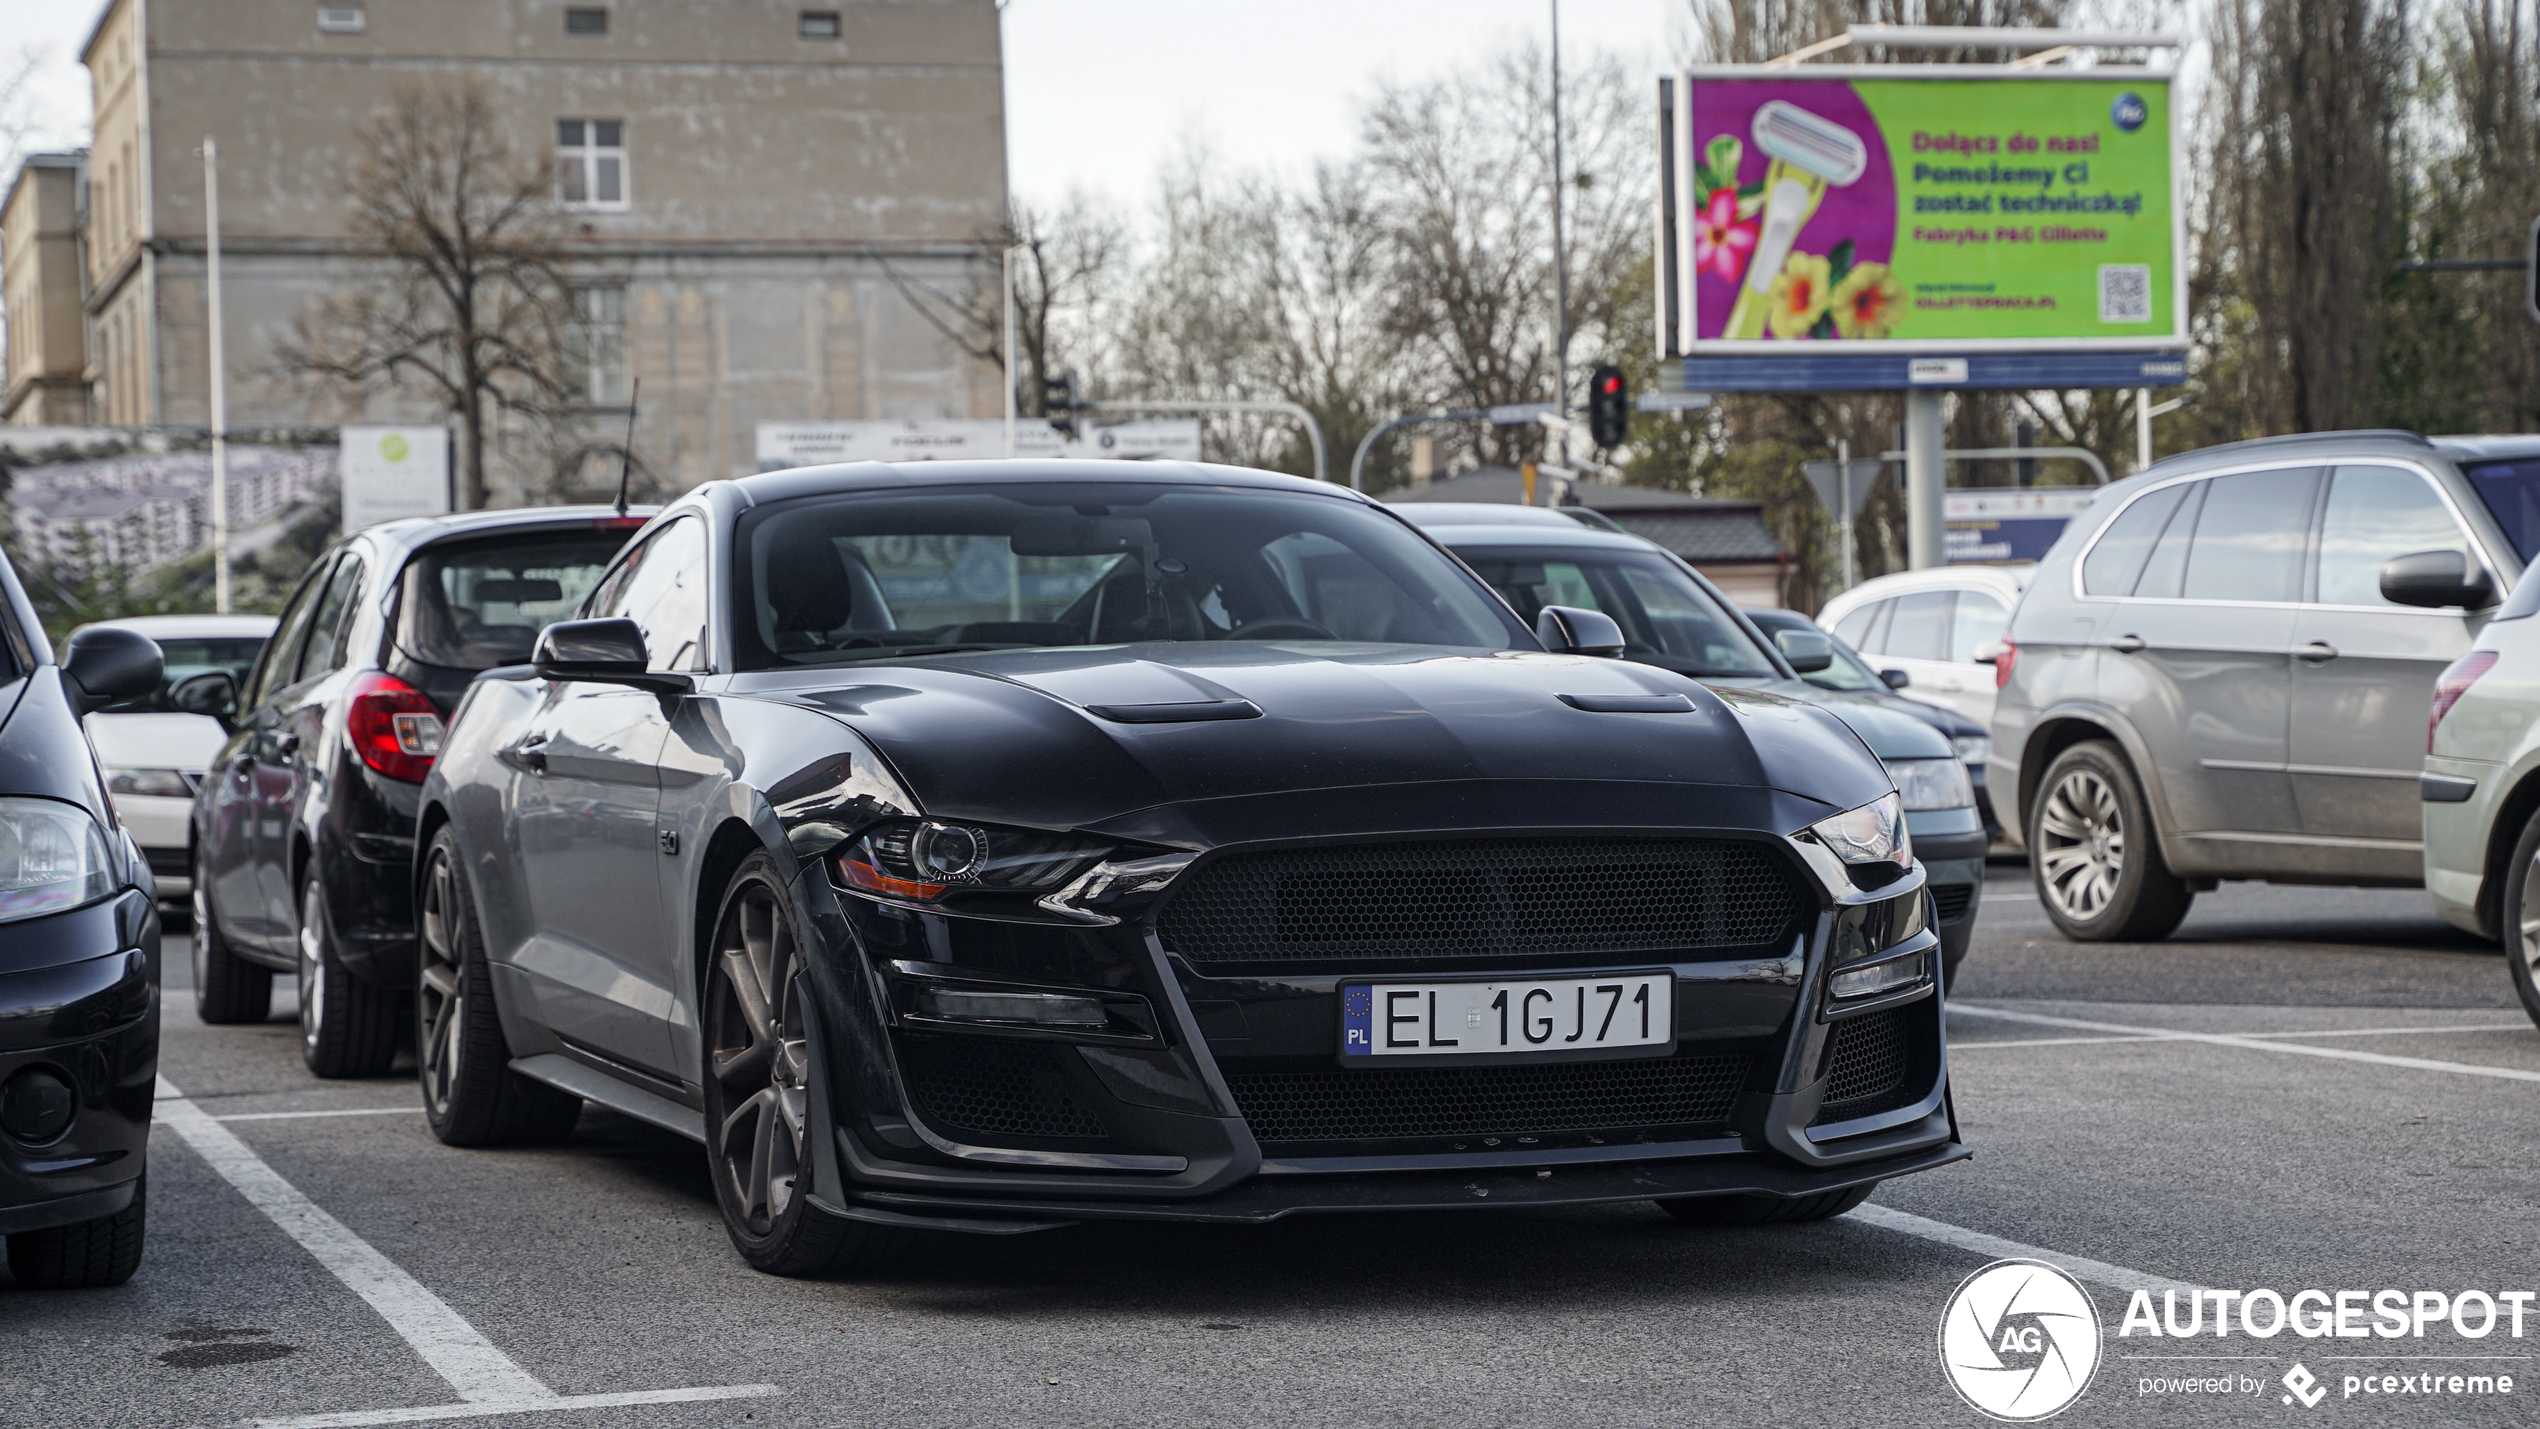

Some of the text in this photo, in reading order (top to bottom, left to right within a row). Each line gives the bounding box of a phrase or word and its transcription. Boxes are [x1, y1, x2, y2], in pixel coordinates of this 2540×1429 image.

[1913, 131, 2099, 157] Dołącz do nas!
[1914, 162, 2088, 187] Pomożemy Ci
[1915, 191, 2141, 217] zostać techniczką!
[1914, 226, 2107, 245] Fabryka P&G Gillette
[1386, 983, 1650, 1048] EL 1GJ71
[1348, 1029, 1368, 1045] PL
